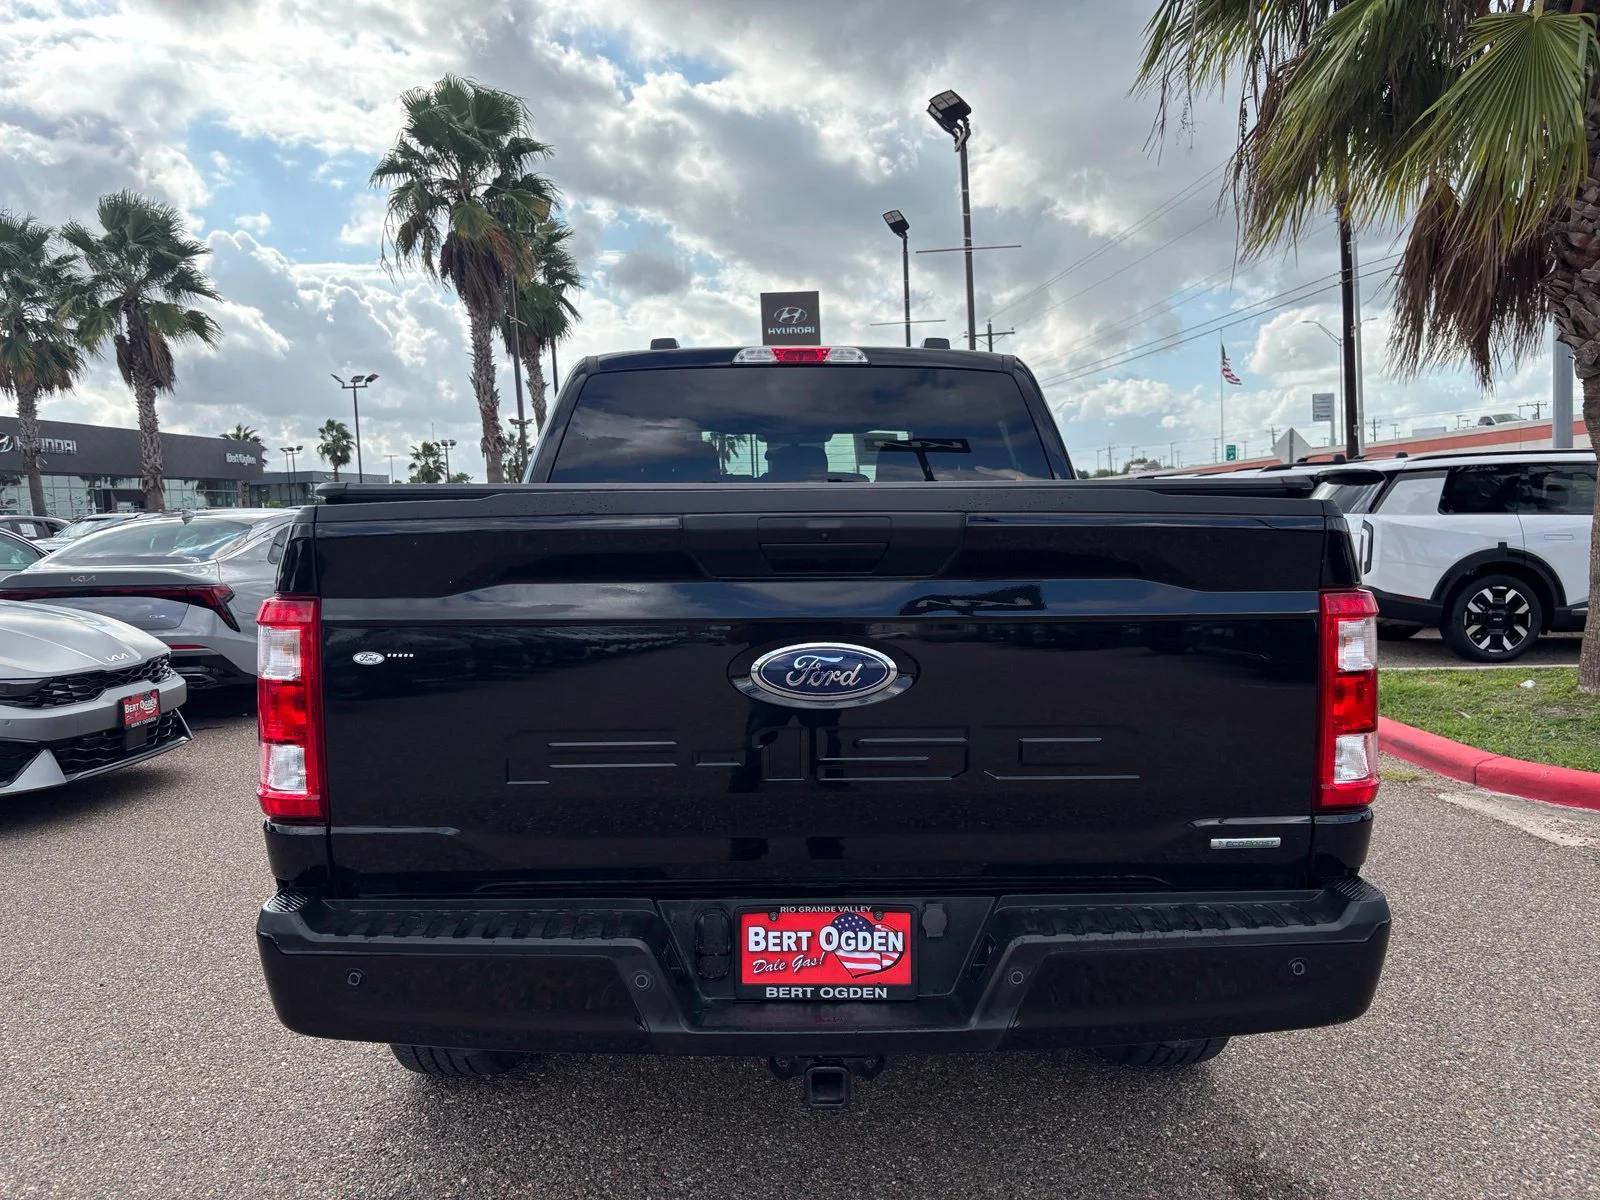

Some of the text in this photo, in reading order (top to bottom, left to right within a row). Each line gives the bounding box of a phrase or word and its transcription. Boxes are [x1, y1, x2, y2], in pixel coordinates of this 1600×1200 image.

[768, 326, 815, 336] HYUNDAI
[786, 655, 863, 687] Ford
[124, 703, 140, 714] BERT
[837, 905, 872, 913] VALLEY
[748, 925, 904, 952] BERT OGDEN
[752, 951, 826, 974] Dale Gas!
[765, 986, 888, 999] BERT OGDEN
